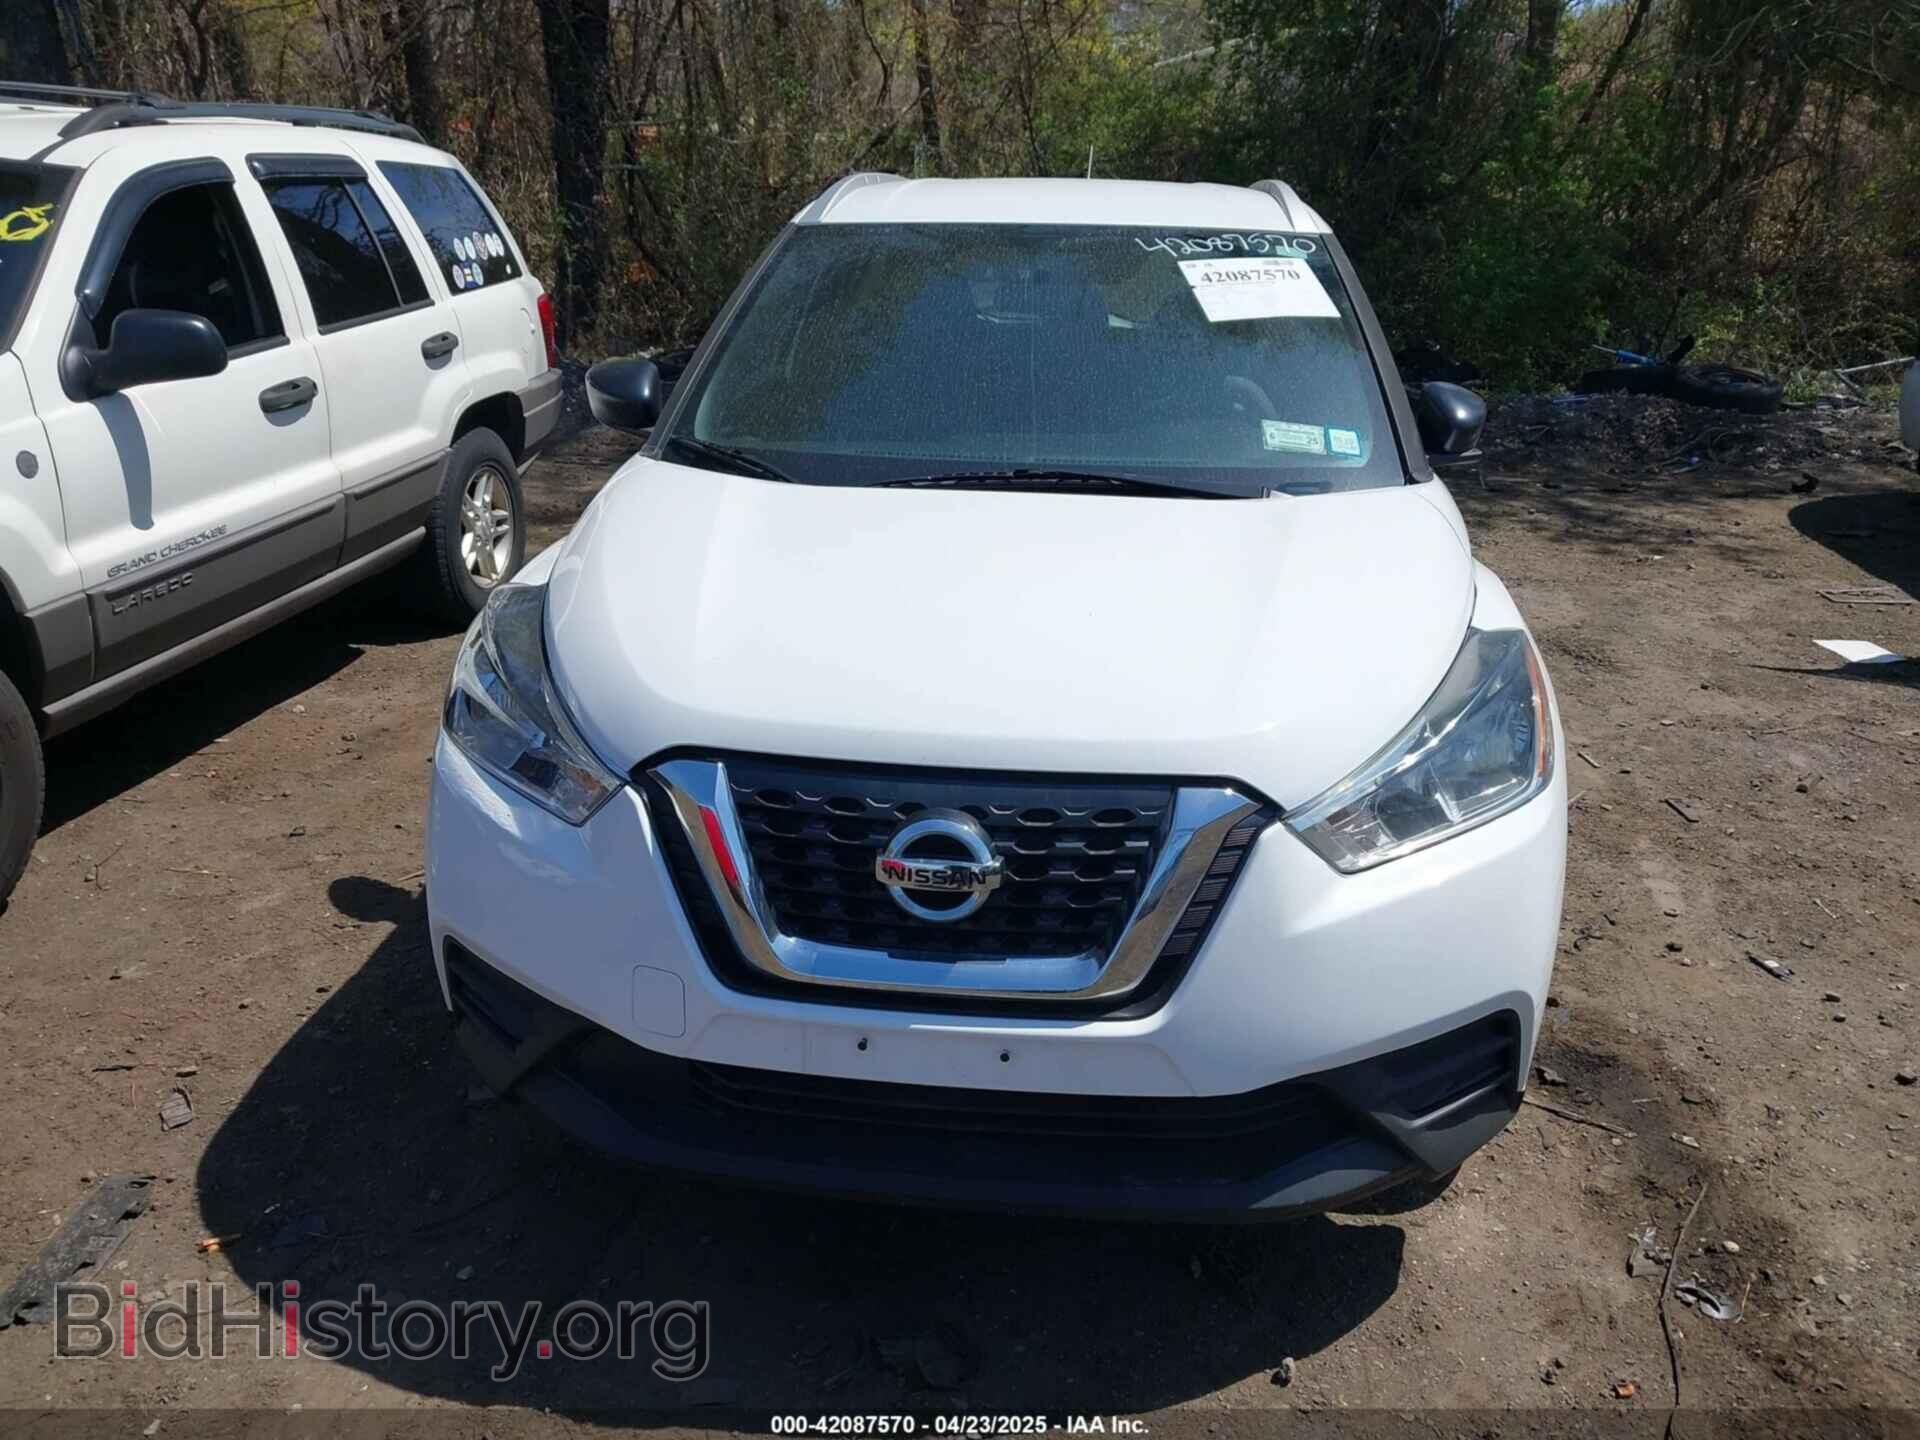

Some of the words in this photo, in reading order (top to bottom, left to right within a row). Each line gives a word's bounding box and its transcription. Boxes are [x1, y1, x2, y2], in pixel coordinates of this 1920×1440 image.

[1135, 233, 1317, 257] 42087570
[1200, 269, 1301, 284] 42087570
[107, 551, 158, 578] GRAND
[160, 524, 227, 558] CHEROKEE
[112, 572, 193, 616] LAREDO
[887, 866, 987, 886] NISSAN
